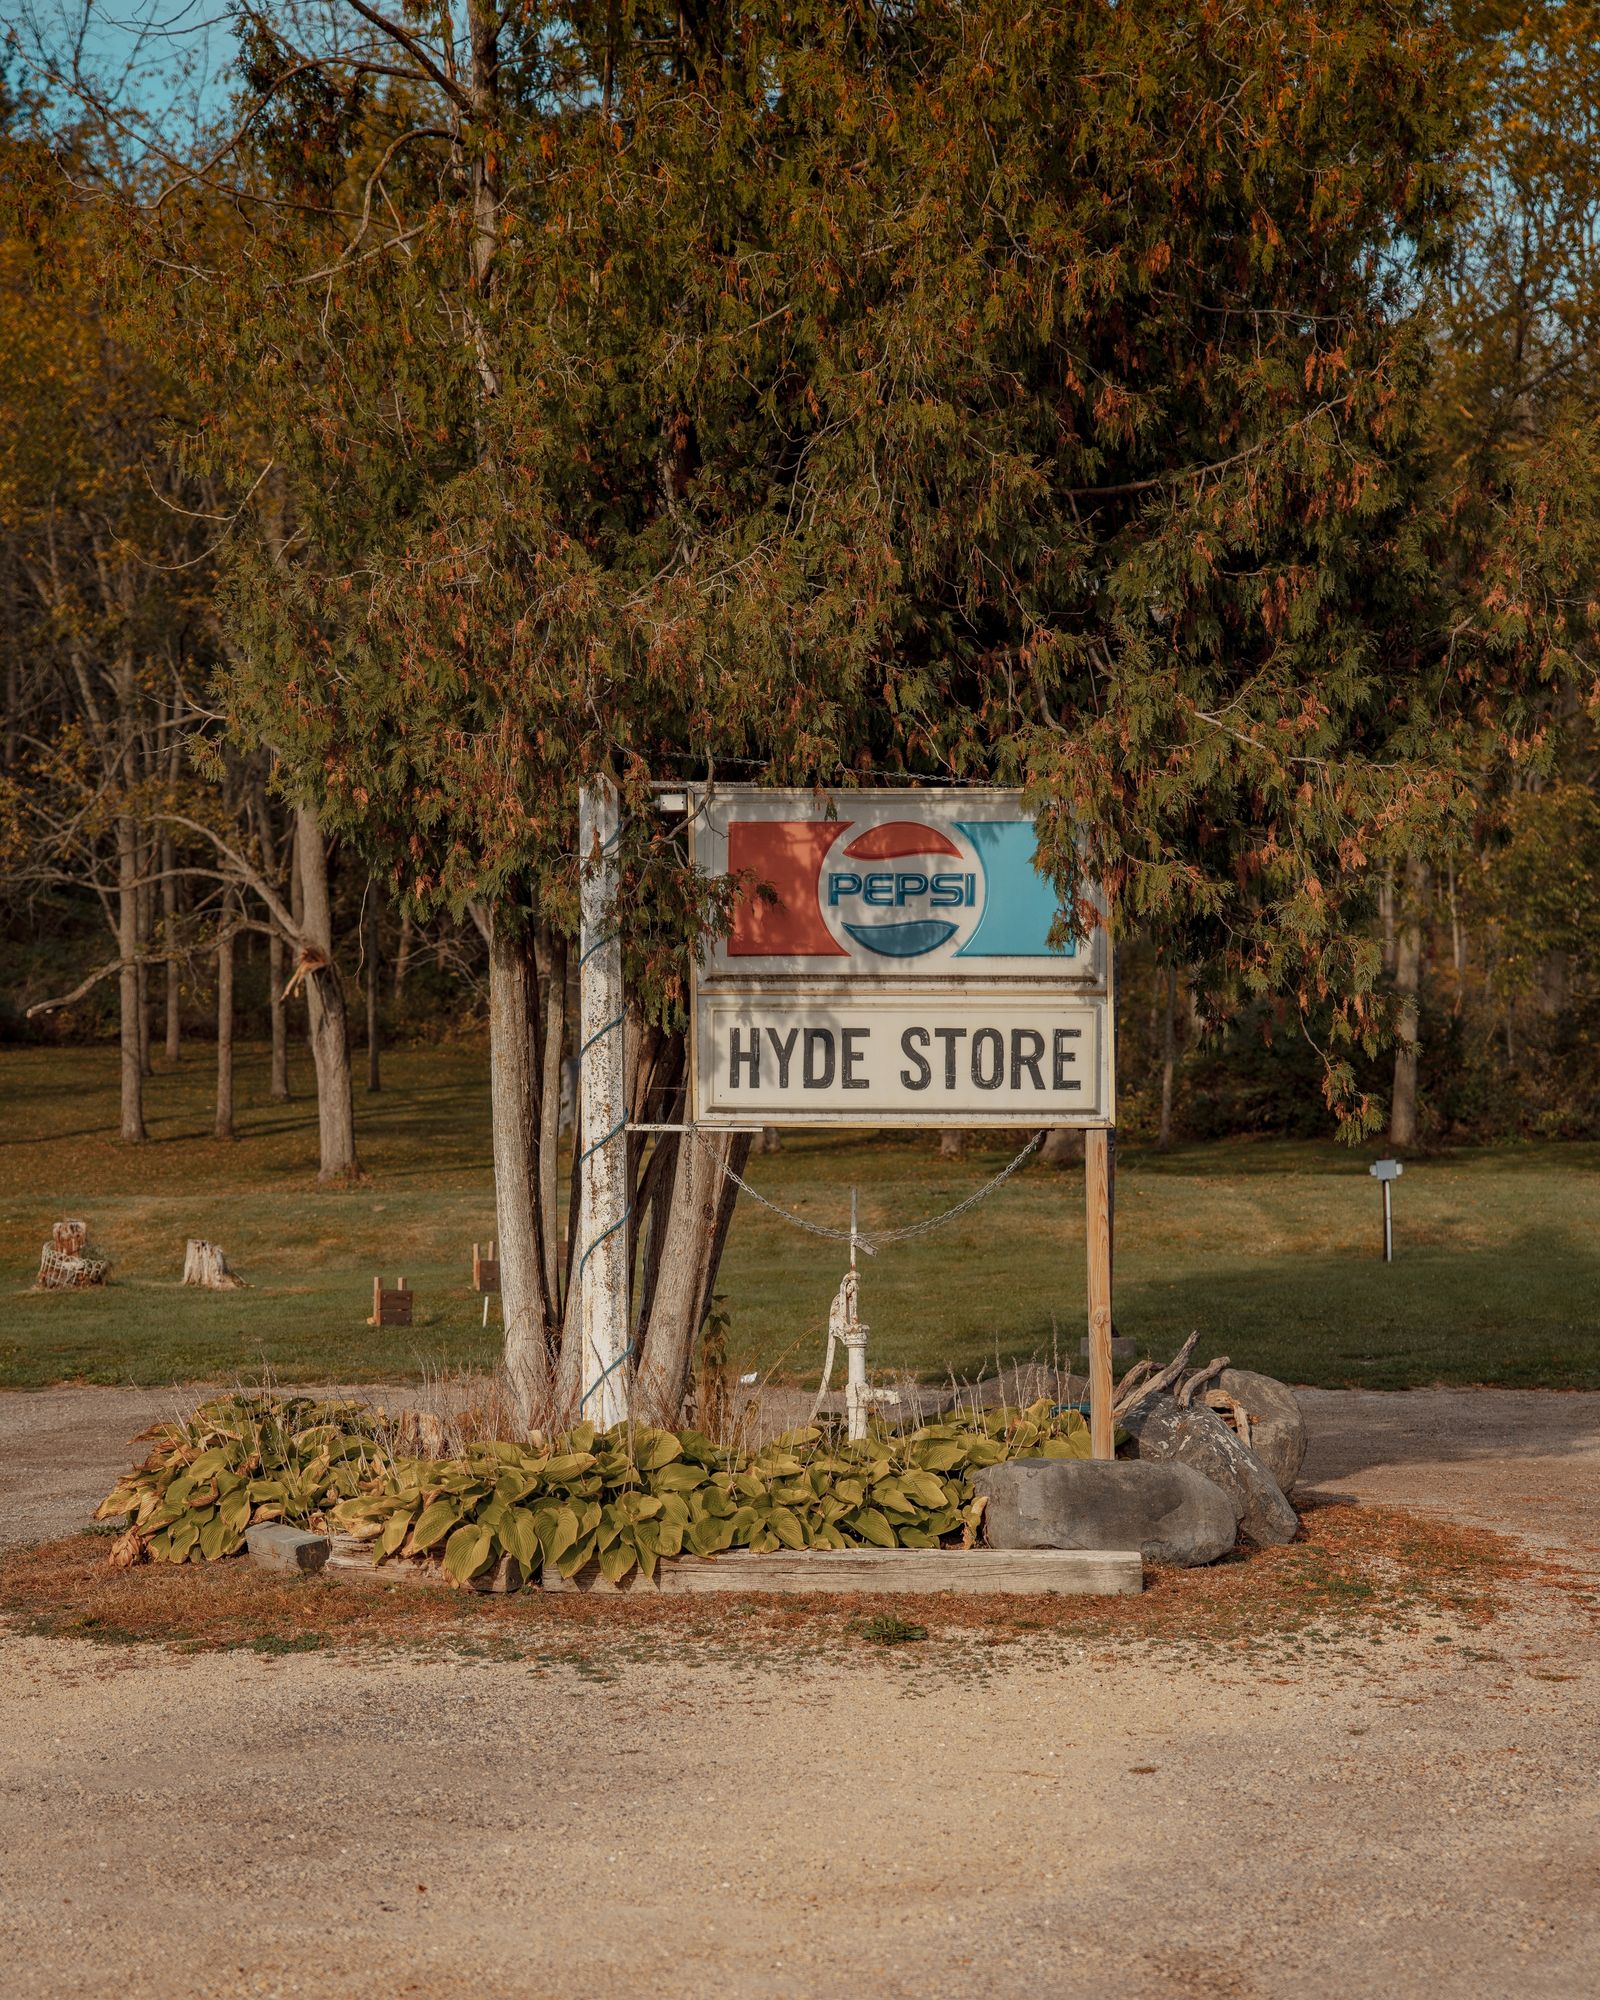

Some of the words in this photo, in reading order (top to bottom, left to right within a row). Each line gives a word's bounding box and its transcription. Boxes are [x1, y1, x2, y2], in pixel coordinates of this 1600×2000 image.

[828, 872, 976, 907] PEPSI
[729, 1027, 870, 1089] HYDE
[900, 1026, 1082, 1091] STORE
